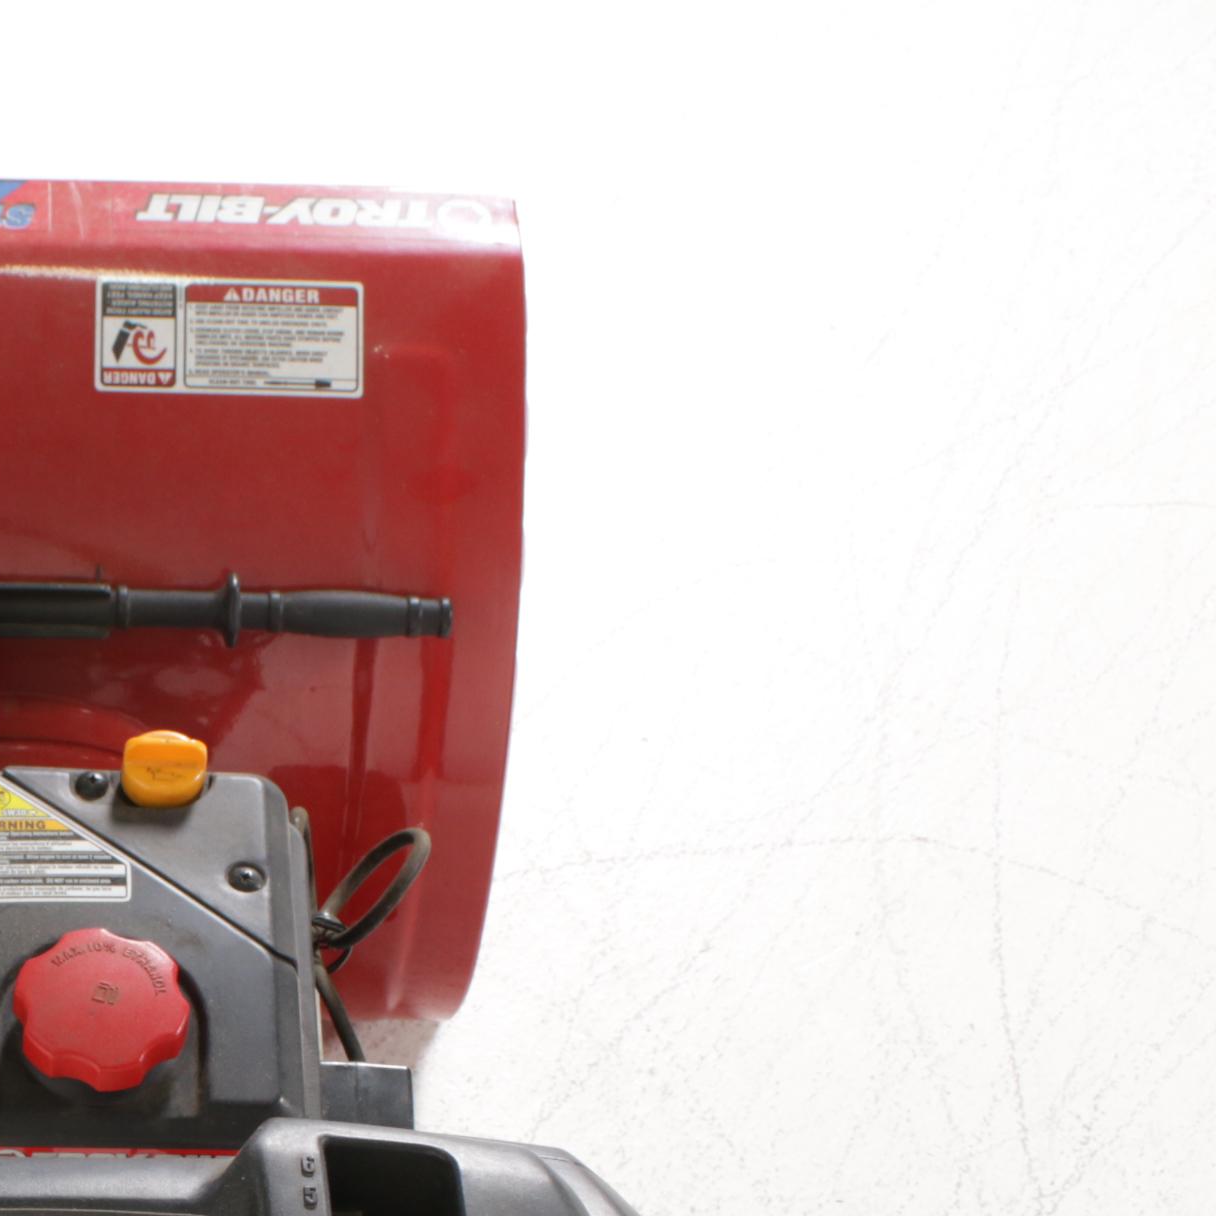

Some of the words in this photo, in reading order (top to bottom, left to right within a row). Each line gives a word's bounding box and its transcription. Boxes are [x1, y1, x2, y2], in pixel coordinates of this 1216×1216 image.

[136, 193, 432, 227] TROY-BILT
[241, 288, 320, 303] DANGER
[104, 370, 156, 385] DANGER
